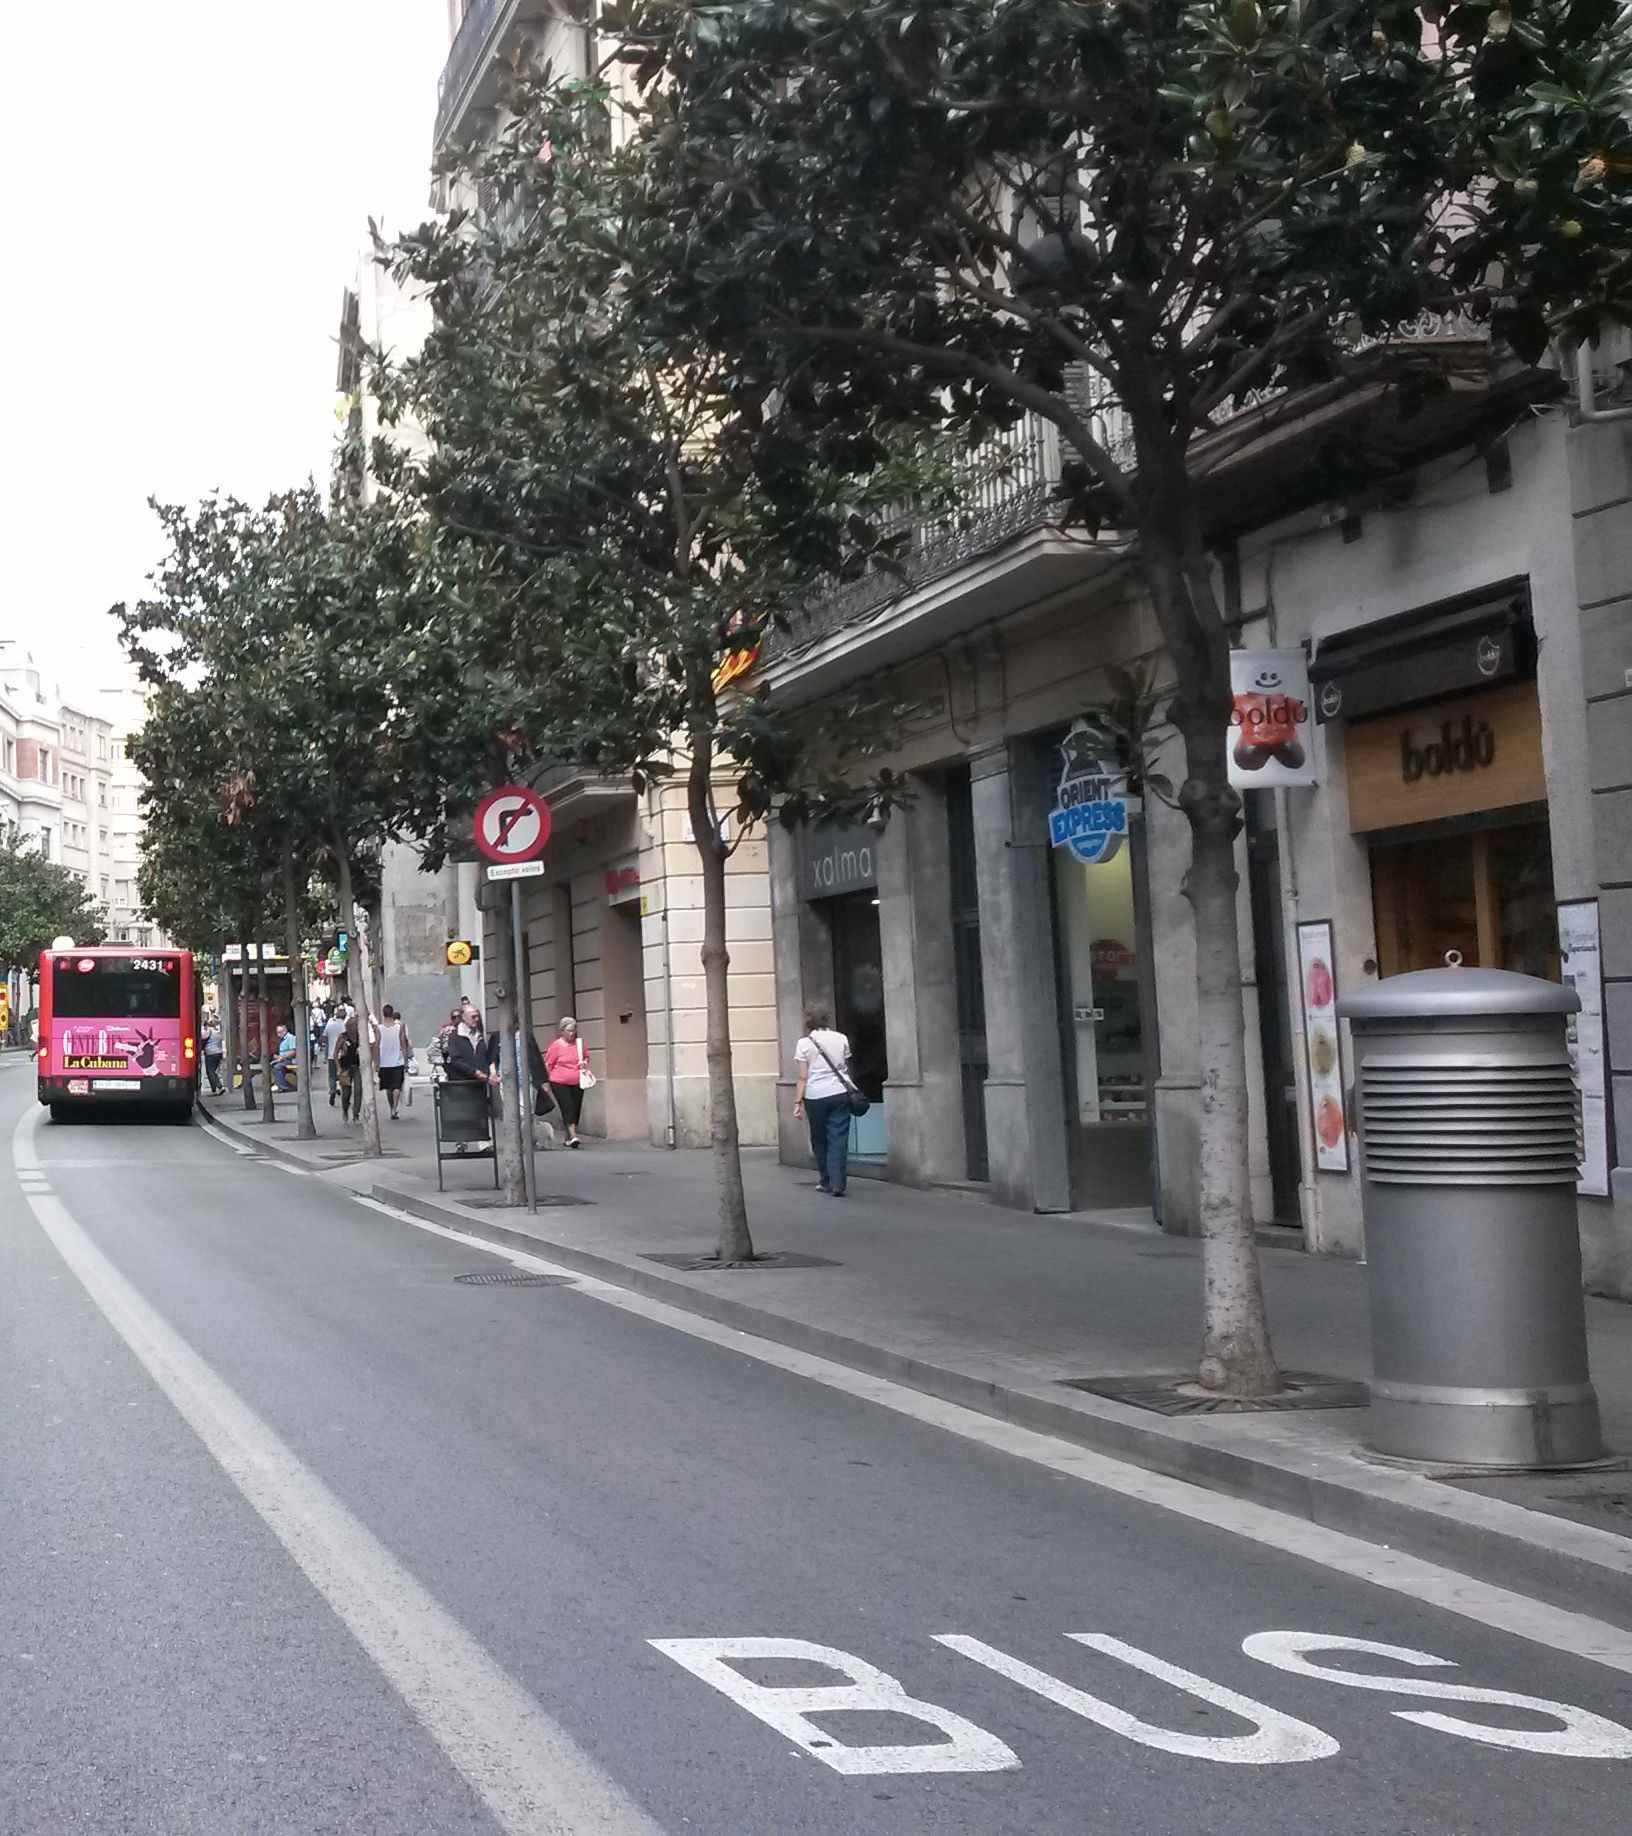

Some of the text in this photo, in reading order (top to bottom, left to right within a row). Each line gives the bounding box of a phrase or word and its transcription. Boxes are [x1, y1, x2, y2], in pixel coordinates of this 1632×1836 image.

[1061, 778, 1111, 809] ORIENT
[1053, 802, 1125, 844] EXPRESS
[133, 959, 164, 971] 2431
[80, 1057, 128, 1069] Cubana
[646, 1630, 1632, 1776] BUS
